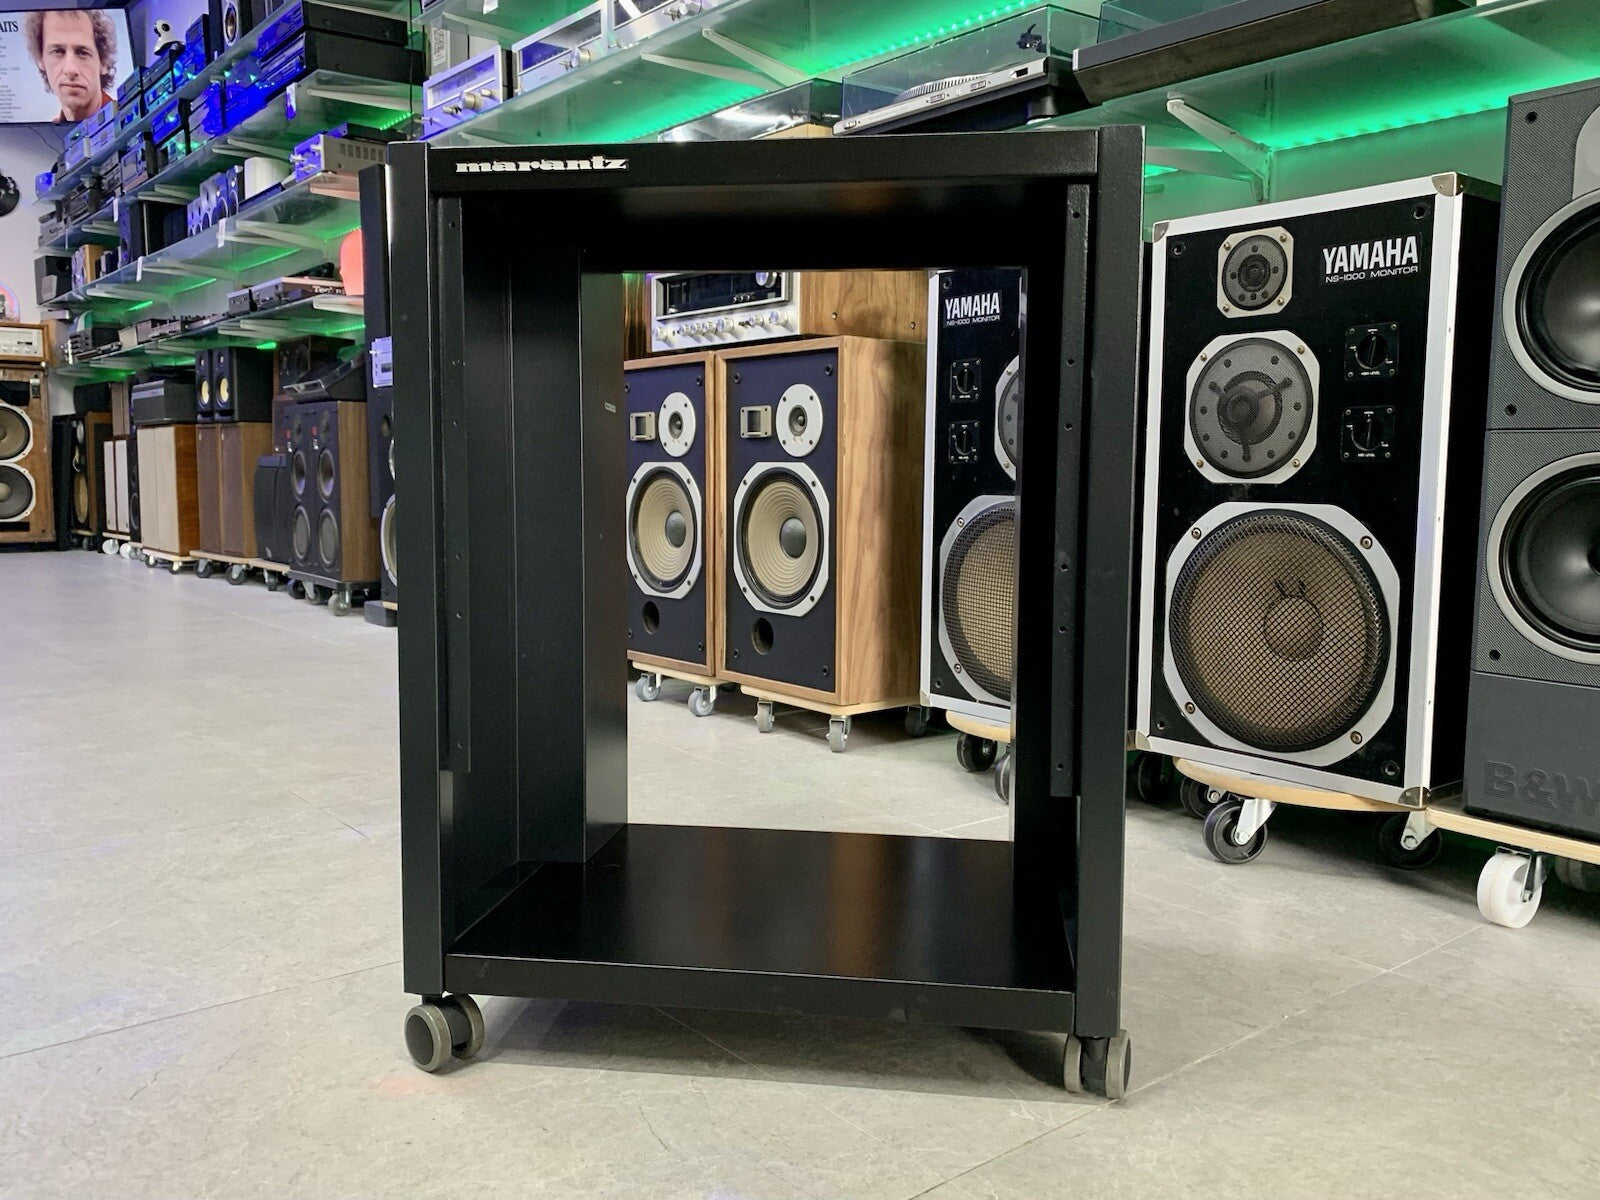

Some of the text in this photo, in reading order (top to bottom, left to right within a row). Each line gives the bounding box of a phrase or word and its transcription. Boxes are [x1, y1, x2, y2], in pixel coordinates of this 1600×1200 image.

[455, 155, 628, 173] marantz
[1322, 235, 1419, 275] YAMAHA
[1325, 265, 1419, 284] NS-1000 MONITOR
[944, 292, 1000, 320] YAMAHA
[971, 314, 1001, 324] MONITOR
